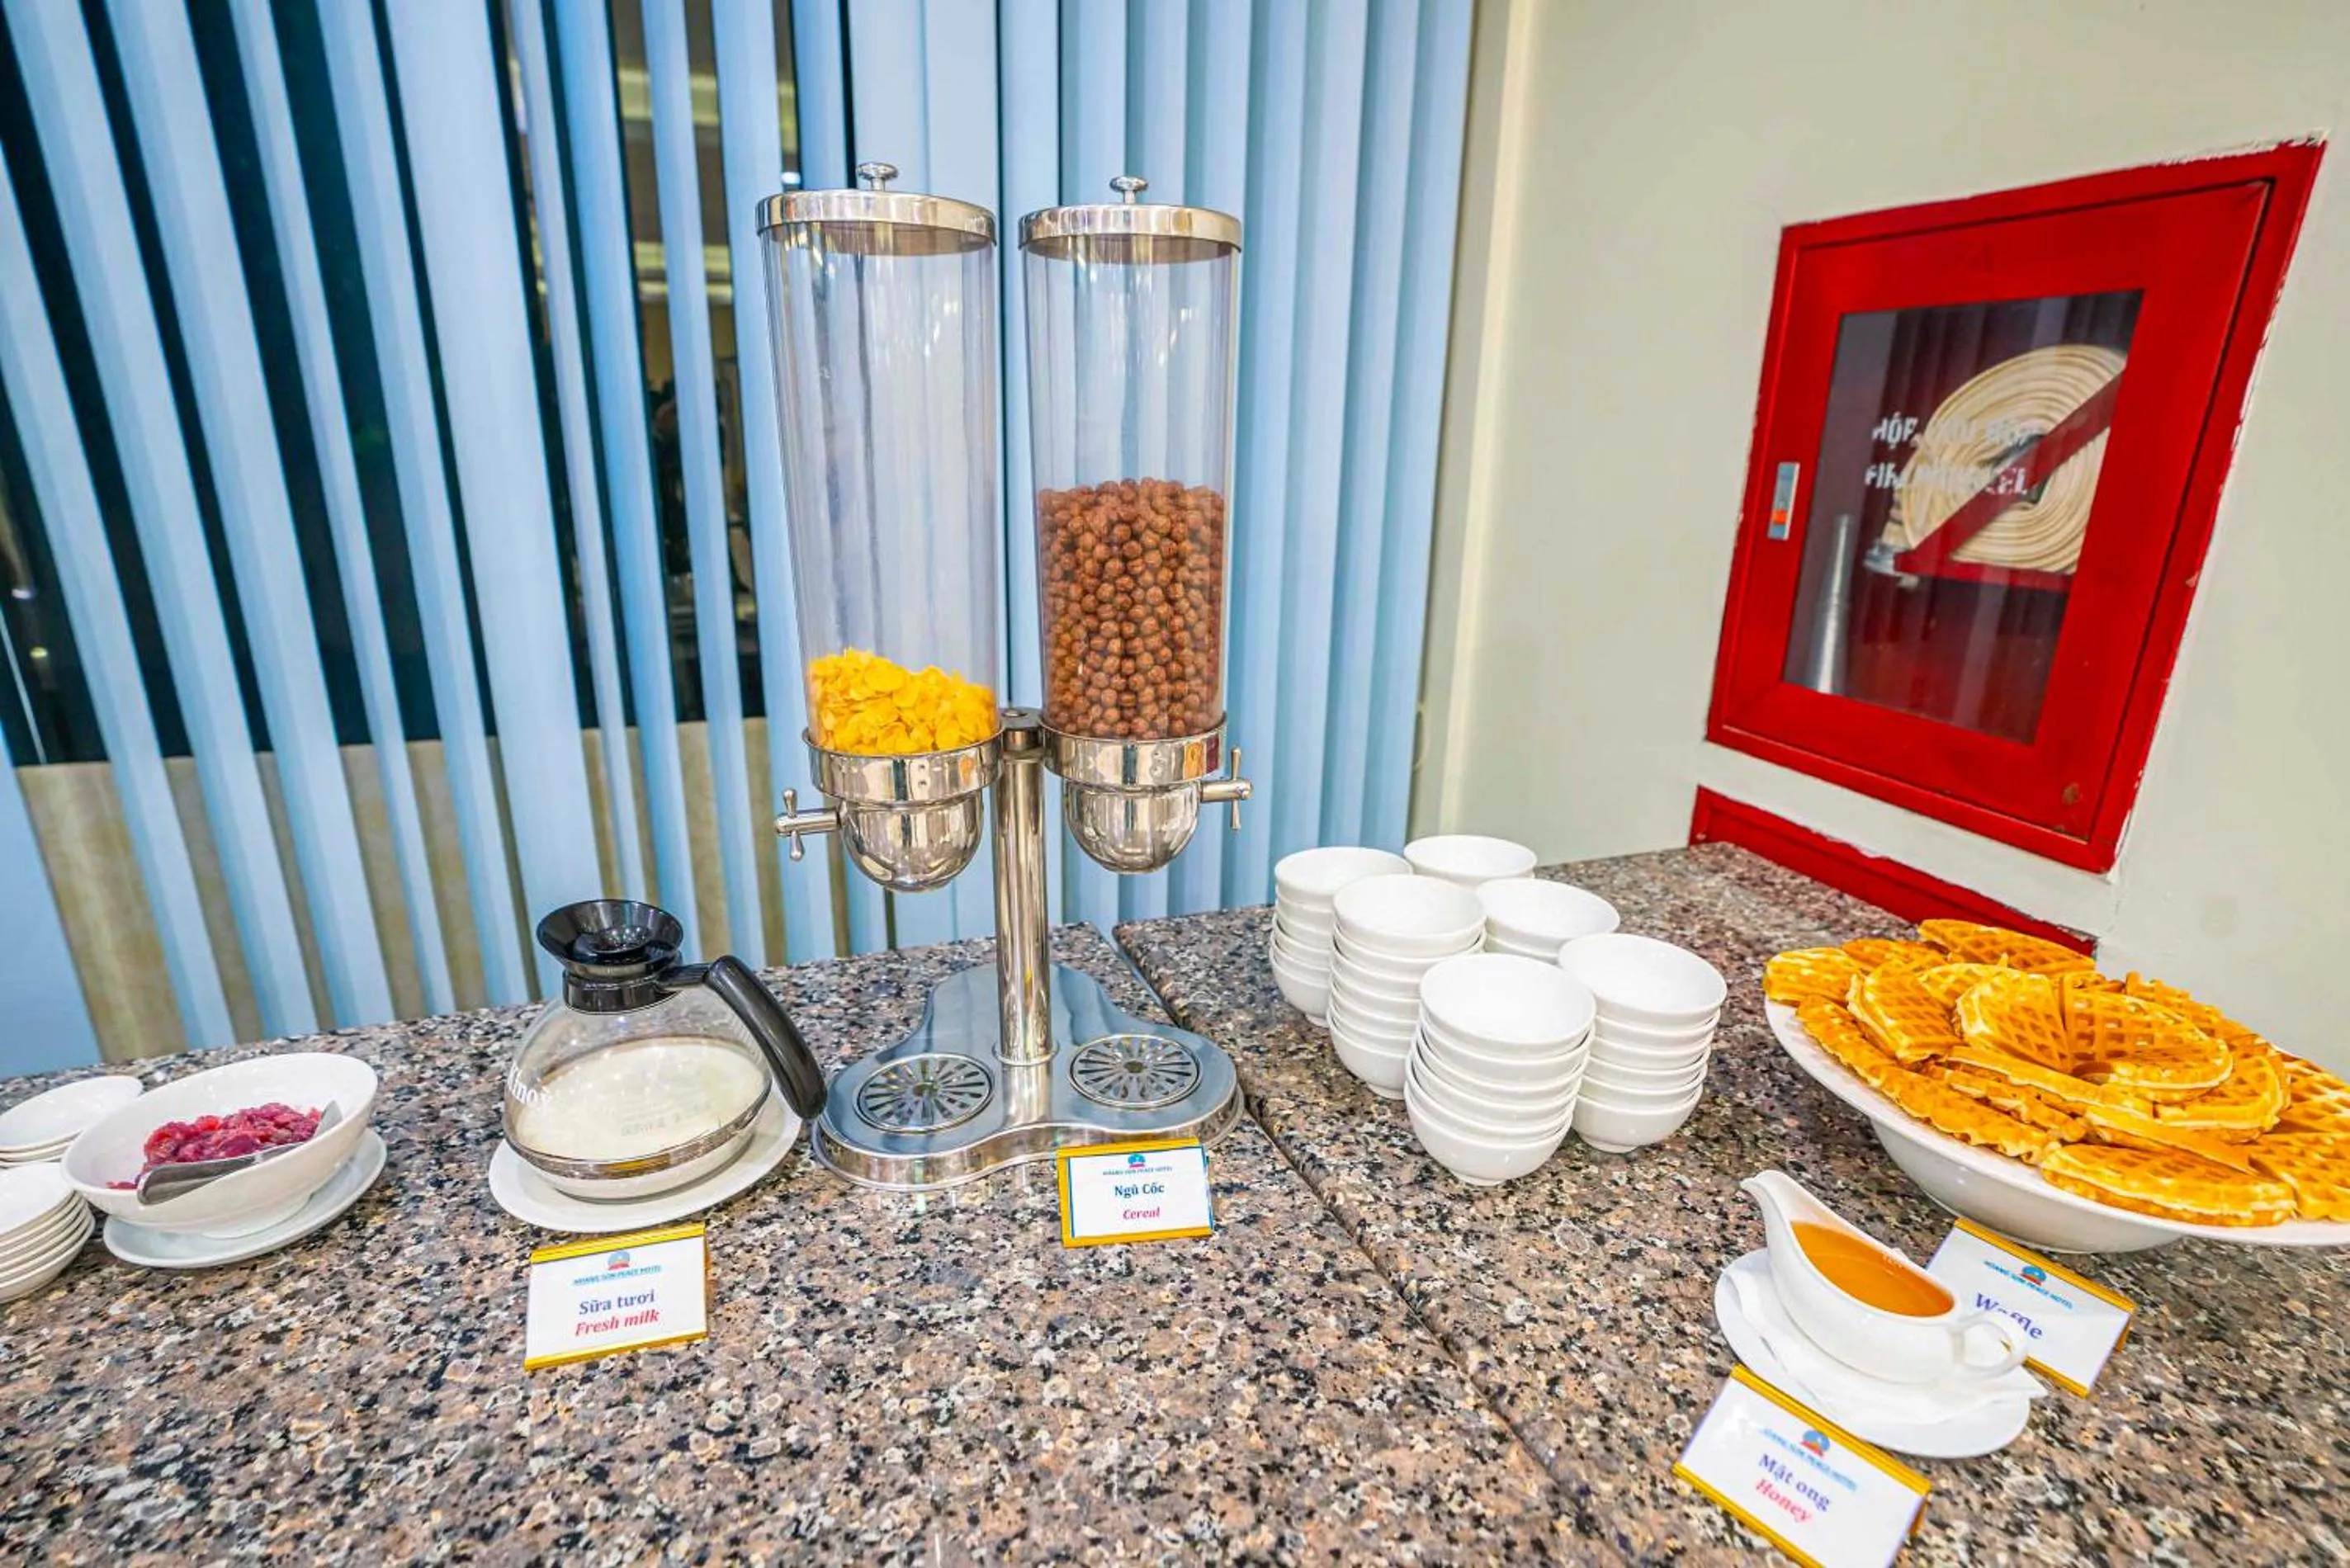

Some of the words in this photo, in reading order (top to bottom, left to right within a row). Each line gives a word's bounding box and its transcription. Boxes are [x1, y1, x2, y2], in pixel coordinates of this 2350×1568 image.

[1123, 1206, 1161, 1220] Cereal
[579, 1296, 612, 1315] Sữa
[617, 1288, 655, 1309] tươi
[1976, 1292, 2042, 1340] Wfle
[574, 1315, 620, 1337] Fresh
[624, 1308, 660, 1328] milk
[1756, 1478, 1813, 1523] Honey
[1796, 1481, 1830, 1514] ong
